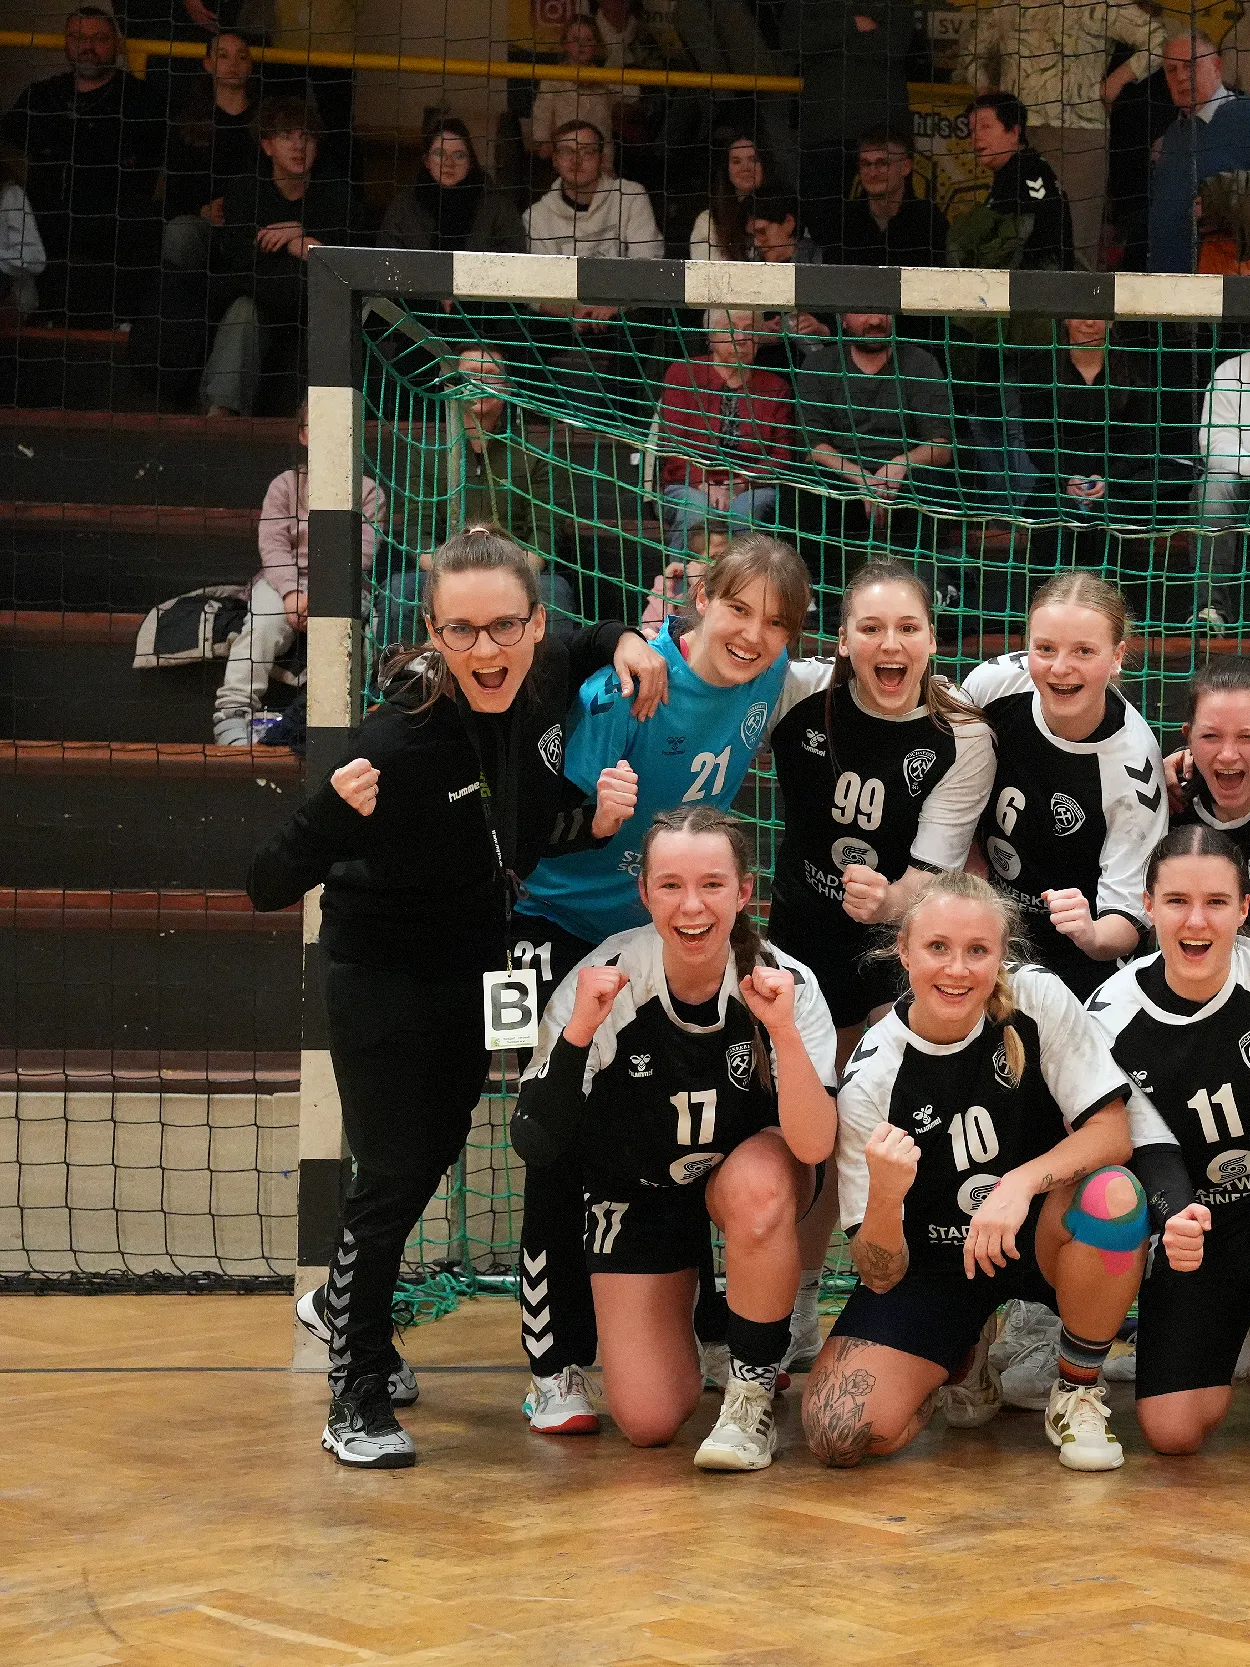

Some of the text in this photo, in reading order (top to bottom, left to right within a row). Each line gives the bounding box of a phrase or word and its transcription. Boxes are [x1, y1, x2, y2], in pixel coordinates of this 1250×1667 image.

[681, 745, 732, 804] 21
[801, 740, 827, 757] hummel
[448, 781, 481, 803] humme
[831, 771, 886, 831] 99
[995, 786, 1026, 837] 6
[513, 940, 554, 982] 21
[491, 982, 532, 1032] B
[670, 1088, 718, 1146] 17
[914, 1116, 943, 1135] hummel
[947, 1105, 1000, 1172] 10
[1186, 1082, 1245, 1144] 11
[591, 1200, 630, 1254] 17
